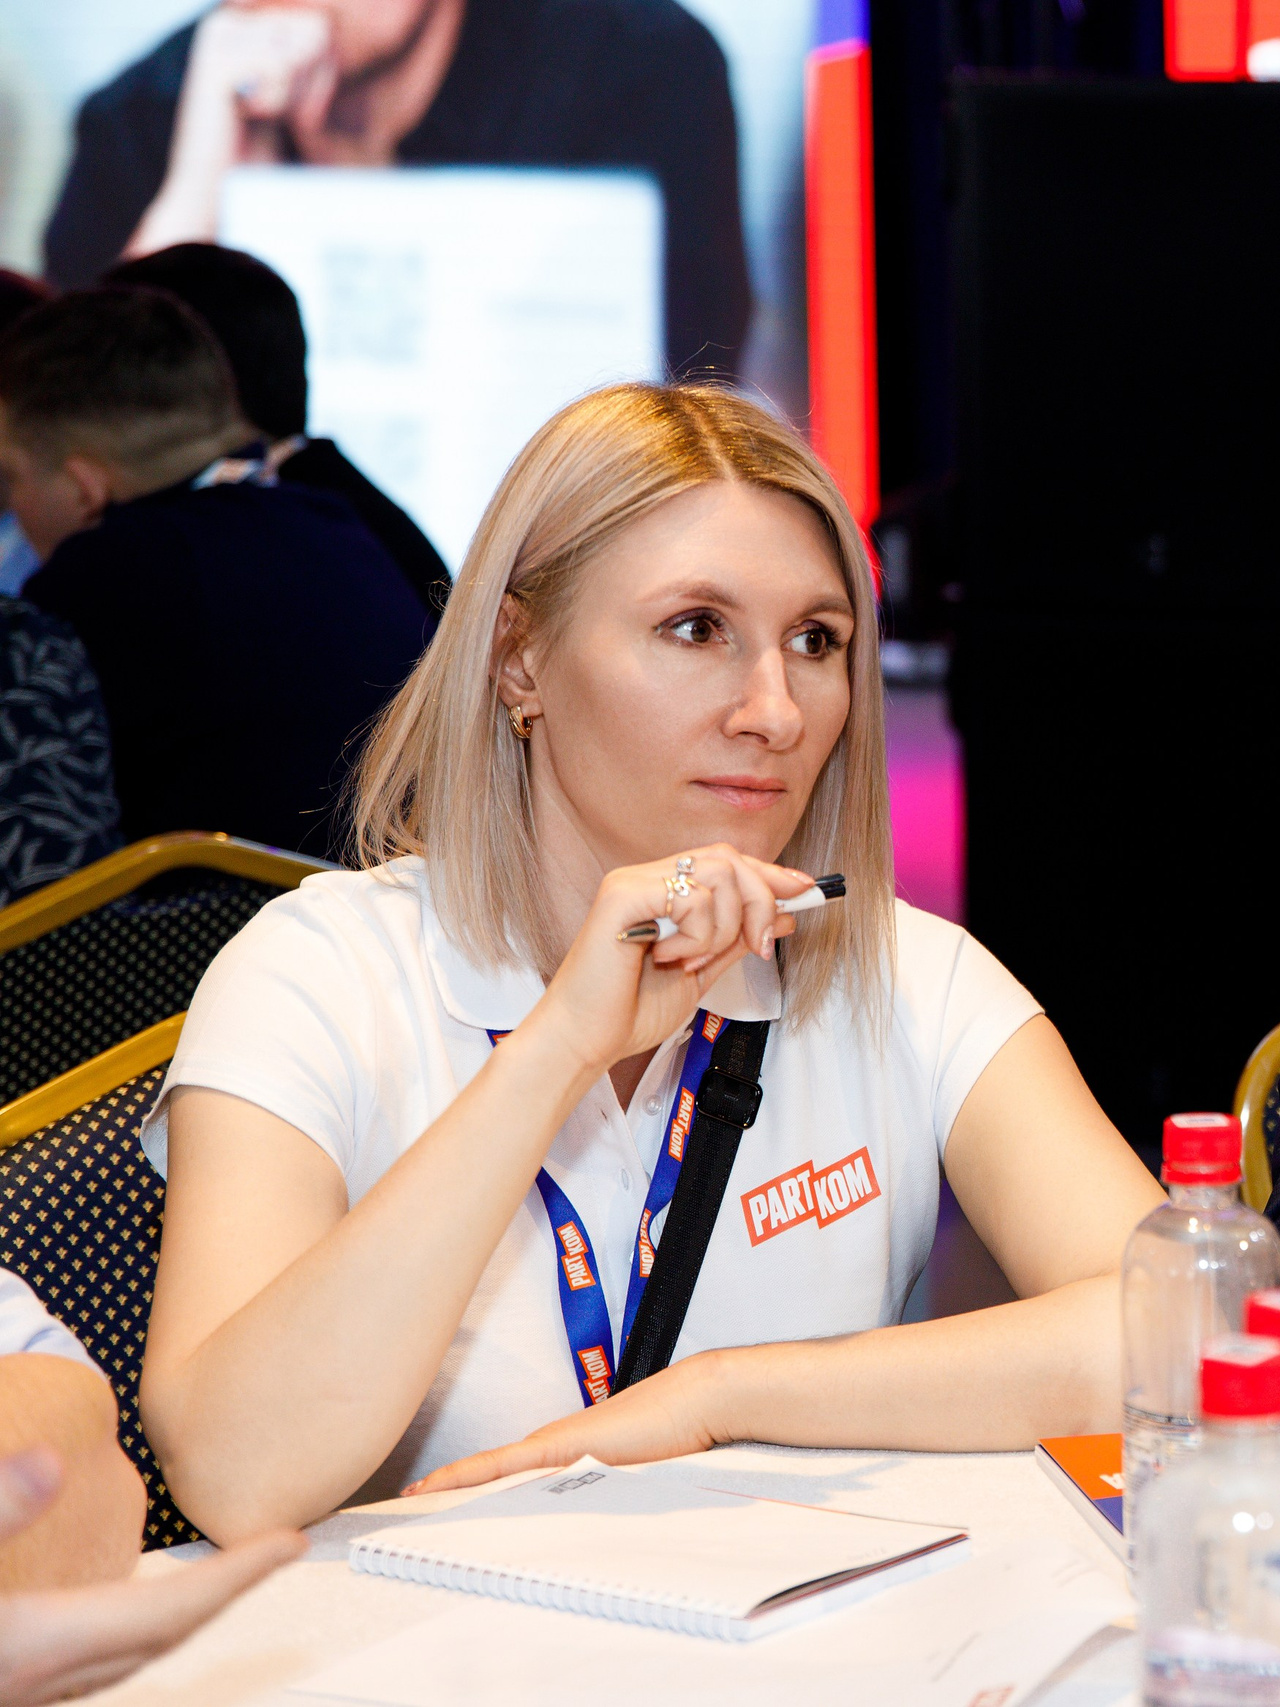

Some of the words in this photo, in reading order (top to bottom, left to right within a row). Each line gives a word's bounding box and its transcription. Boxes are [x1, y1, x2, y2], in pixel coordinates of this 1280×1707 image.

[704, 1013, 722, 1040] OM
[749, 1168, 815, 1238] PART
[813, 1156, 873, 1220] KOM
[587, 1379, 609, 1404] ART
